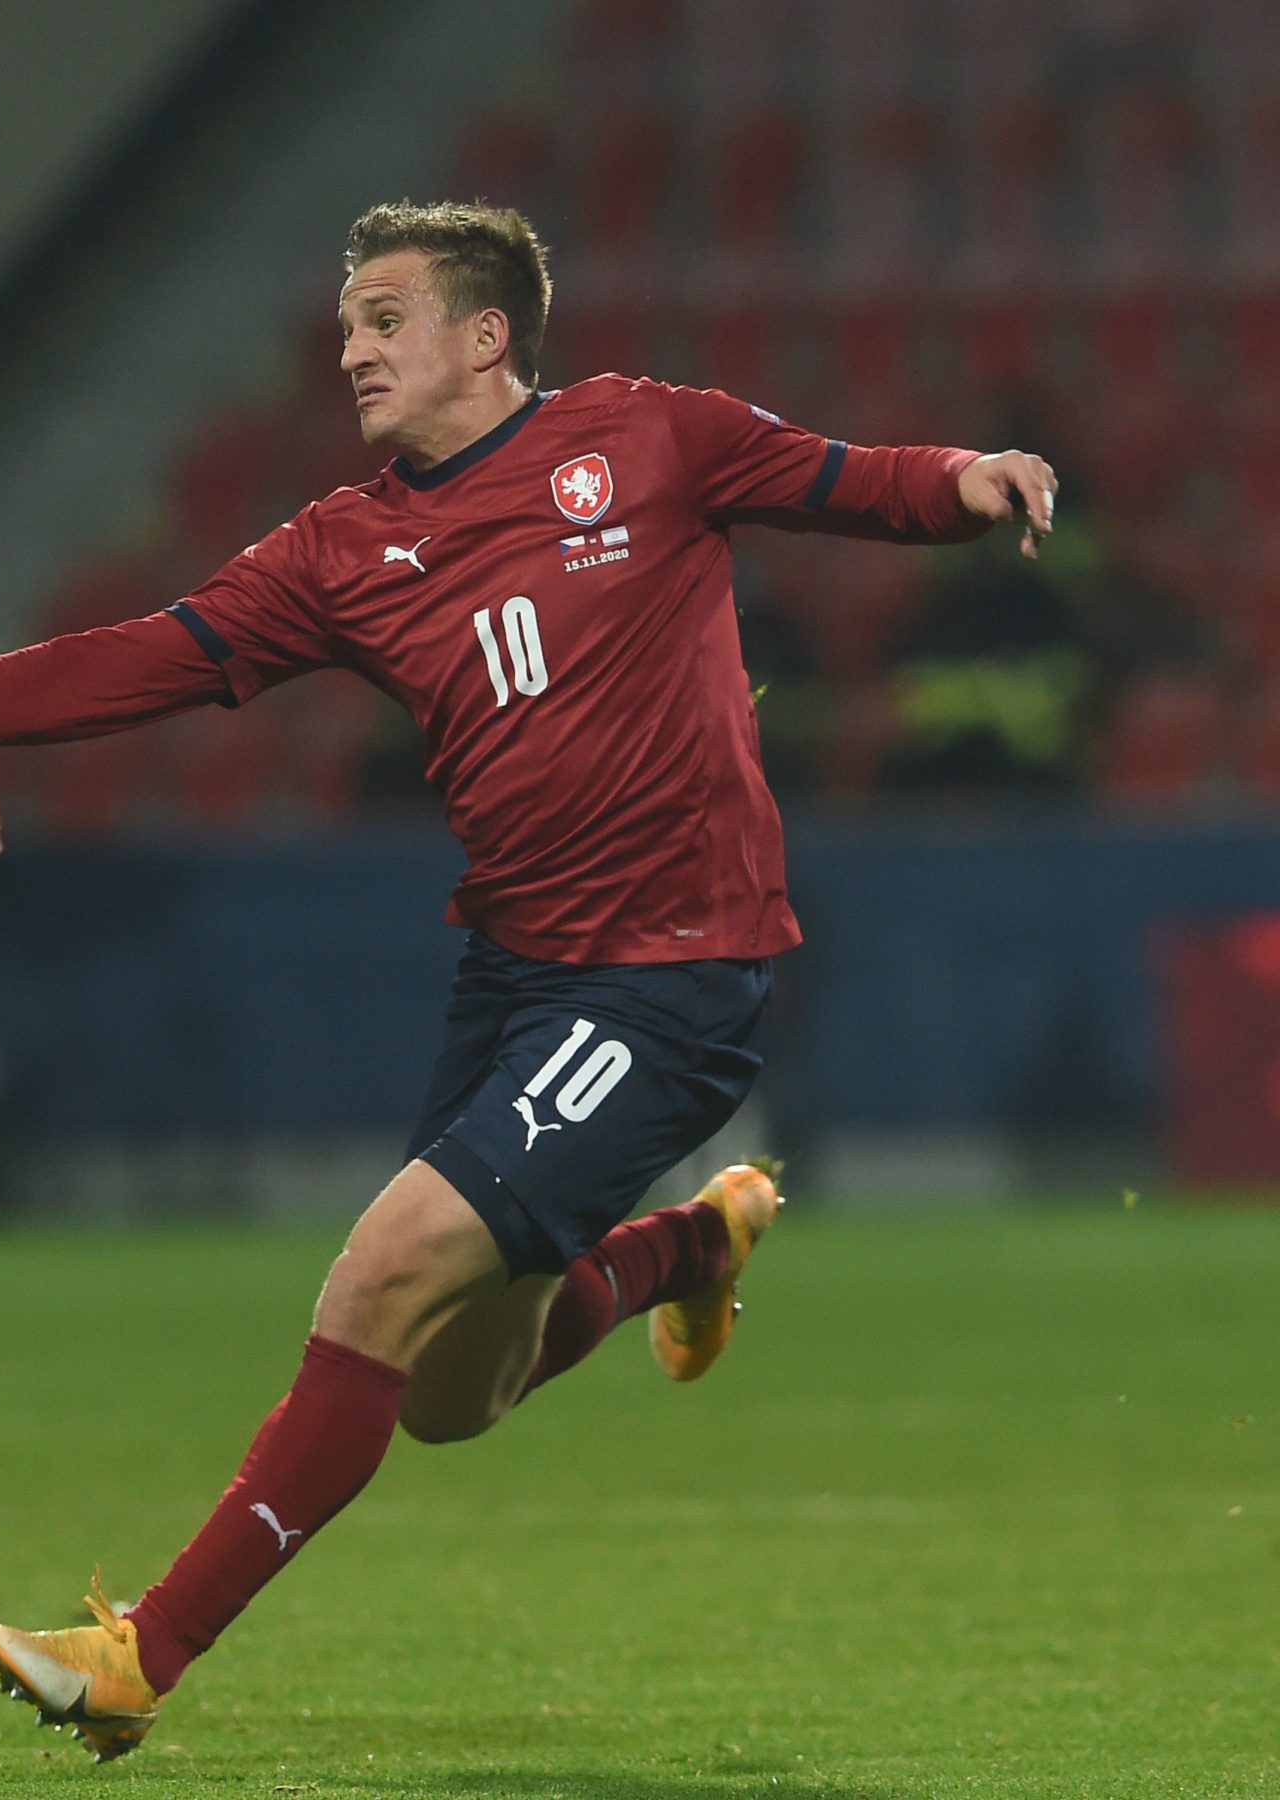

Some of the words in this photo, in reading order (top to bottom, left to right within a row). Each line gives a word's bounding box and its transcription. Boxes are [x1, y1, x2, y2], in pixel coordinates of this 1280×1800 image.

[564, 548, 630, 573] 15.11.2020
[473, 596, 548, 708] 10
[523, 1018, 632, 1122] 10
